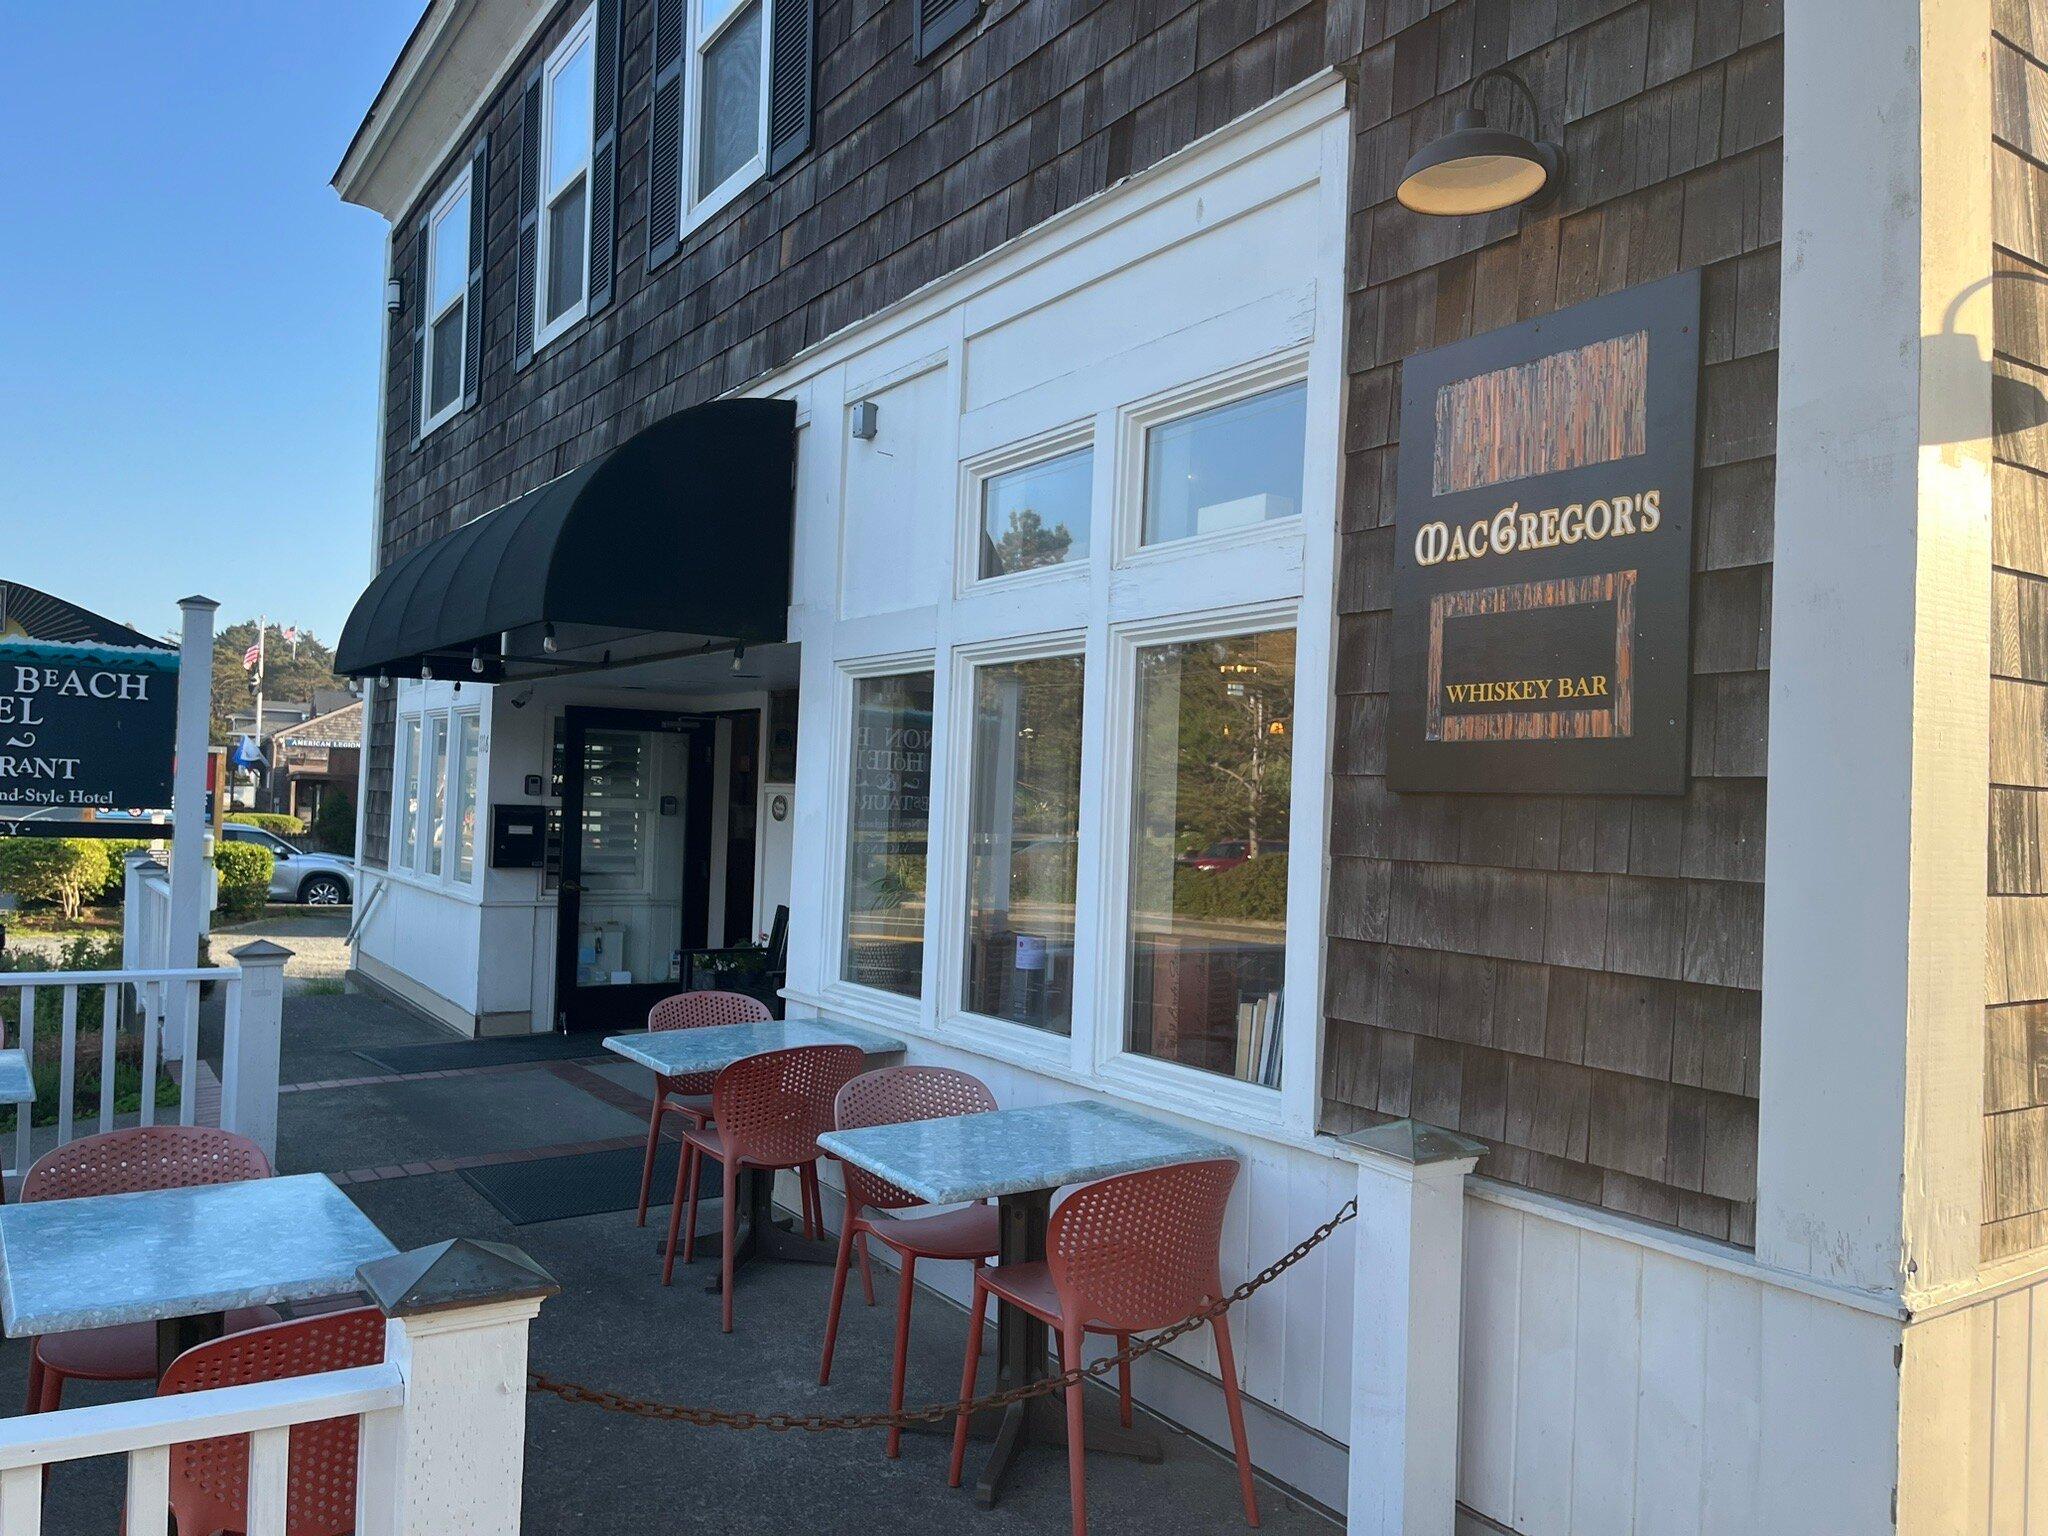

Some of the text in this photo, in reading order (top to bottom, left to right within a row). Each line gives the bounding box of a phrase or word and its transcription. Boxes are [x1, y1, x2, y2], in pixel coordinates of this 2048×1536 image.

[1414, 490, 1661, 566] MACGREGOR'S
[14, 666, 149, 700] BEACH
[1446, 675, 1608, 703] WHISKEY BAR
[292, 739, 331, 747] AMERICAN
[69, 790, 114, 804] Hotel
